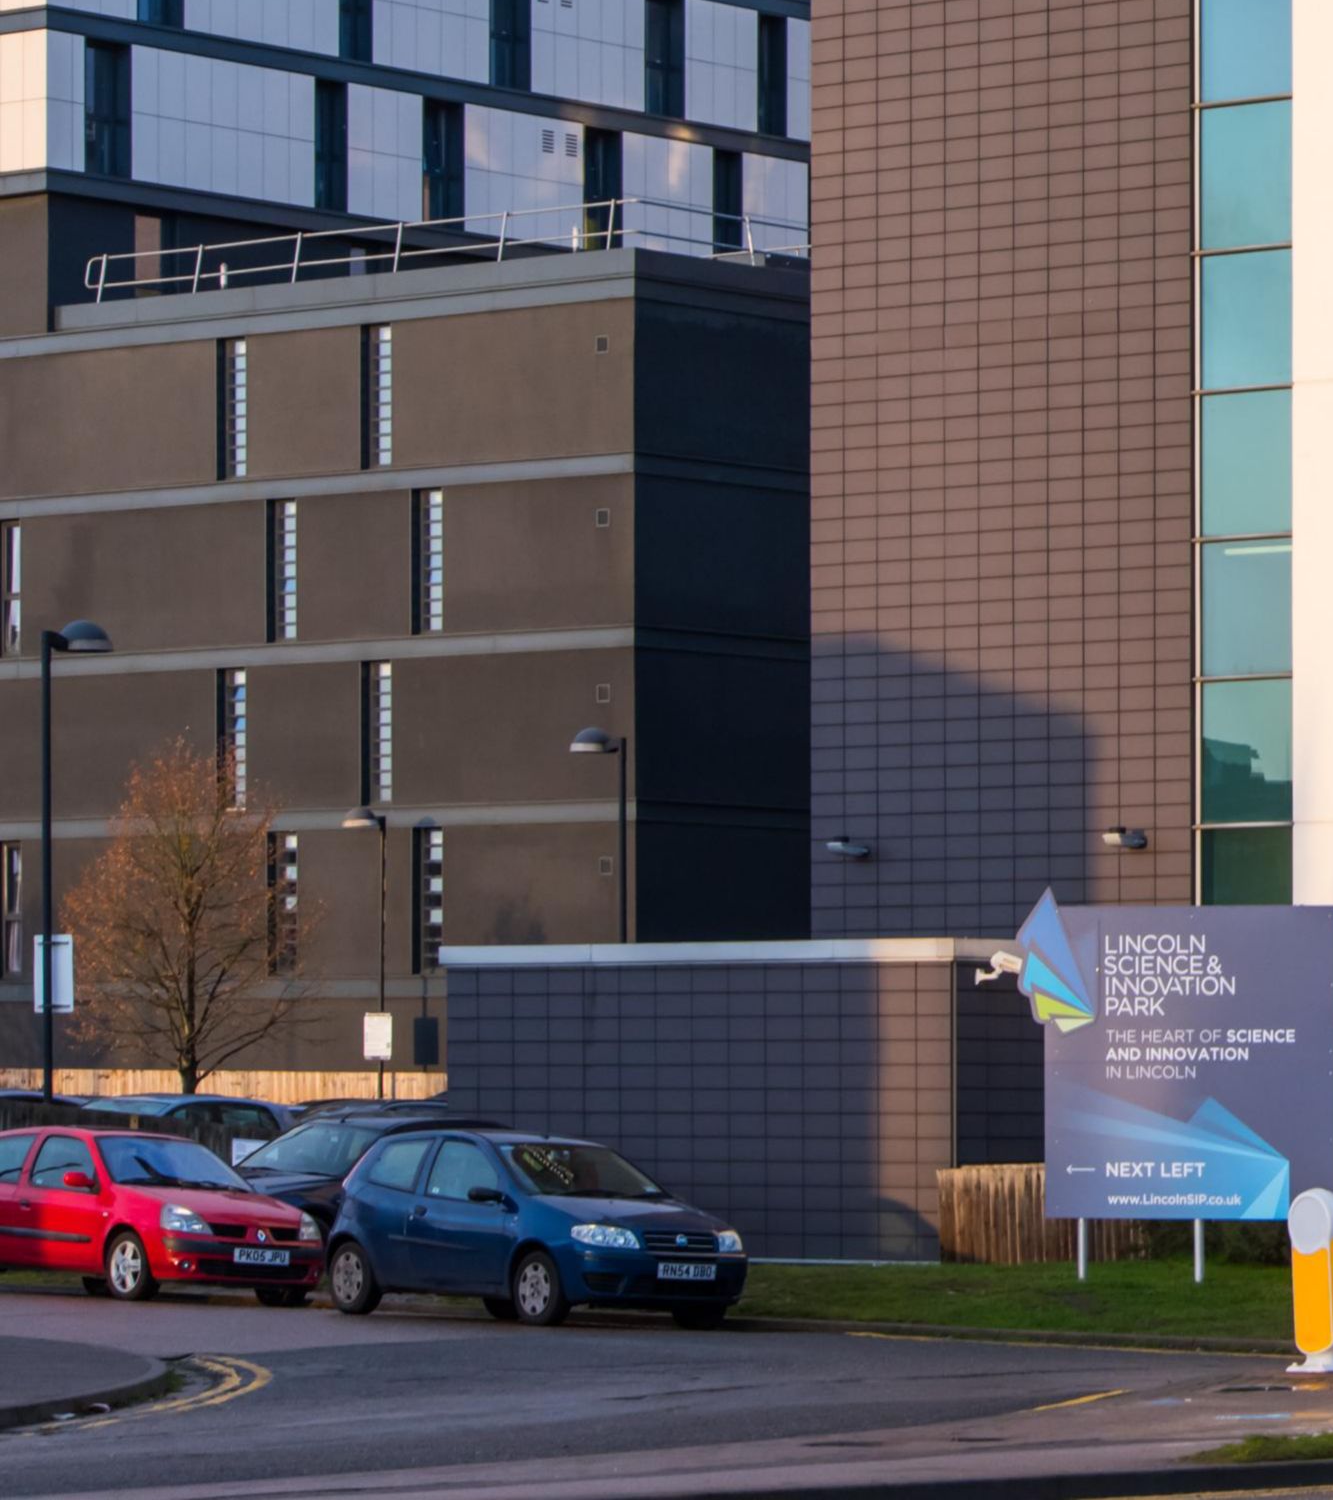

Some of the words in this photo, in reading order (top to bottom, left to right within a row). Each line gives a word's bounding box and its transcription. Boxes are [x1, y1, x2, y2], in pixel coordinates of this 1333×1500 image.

[1104, 934, 1206, 954] LINCOLN
[1104, 976, 1236, 996] INNOVATION
[1104, 997, 1165, 1016] PARK
[1106, 1029, 1136, 1043] THE
[1141, 1029, 1195, 1043] HEART
[1199, 1029, 1222, 1043] OF
[1226, 1029, 1296, 1043] SCIENCE
[1105, 1047, 1141, 1061] AND
[1145, 1047, 1249, 1061] INNOVATION
[1106, 1066, 1122, 1079] IN
[1126, 1065, 1196, 1079] LINCOLN
[1105, 1162, 1155, 1177] NEXT
[1160, 1162, 1206, 1177] LEFT
[1107, 1194, 1242, 1206] www.LincolnSIP.co.uk
[238, 1249, 266, 1261] PK05
[268, 1251, 287, 1263] JPU
[662, 1264, 690, 1277] RN54
